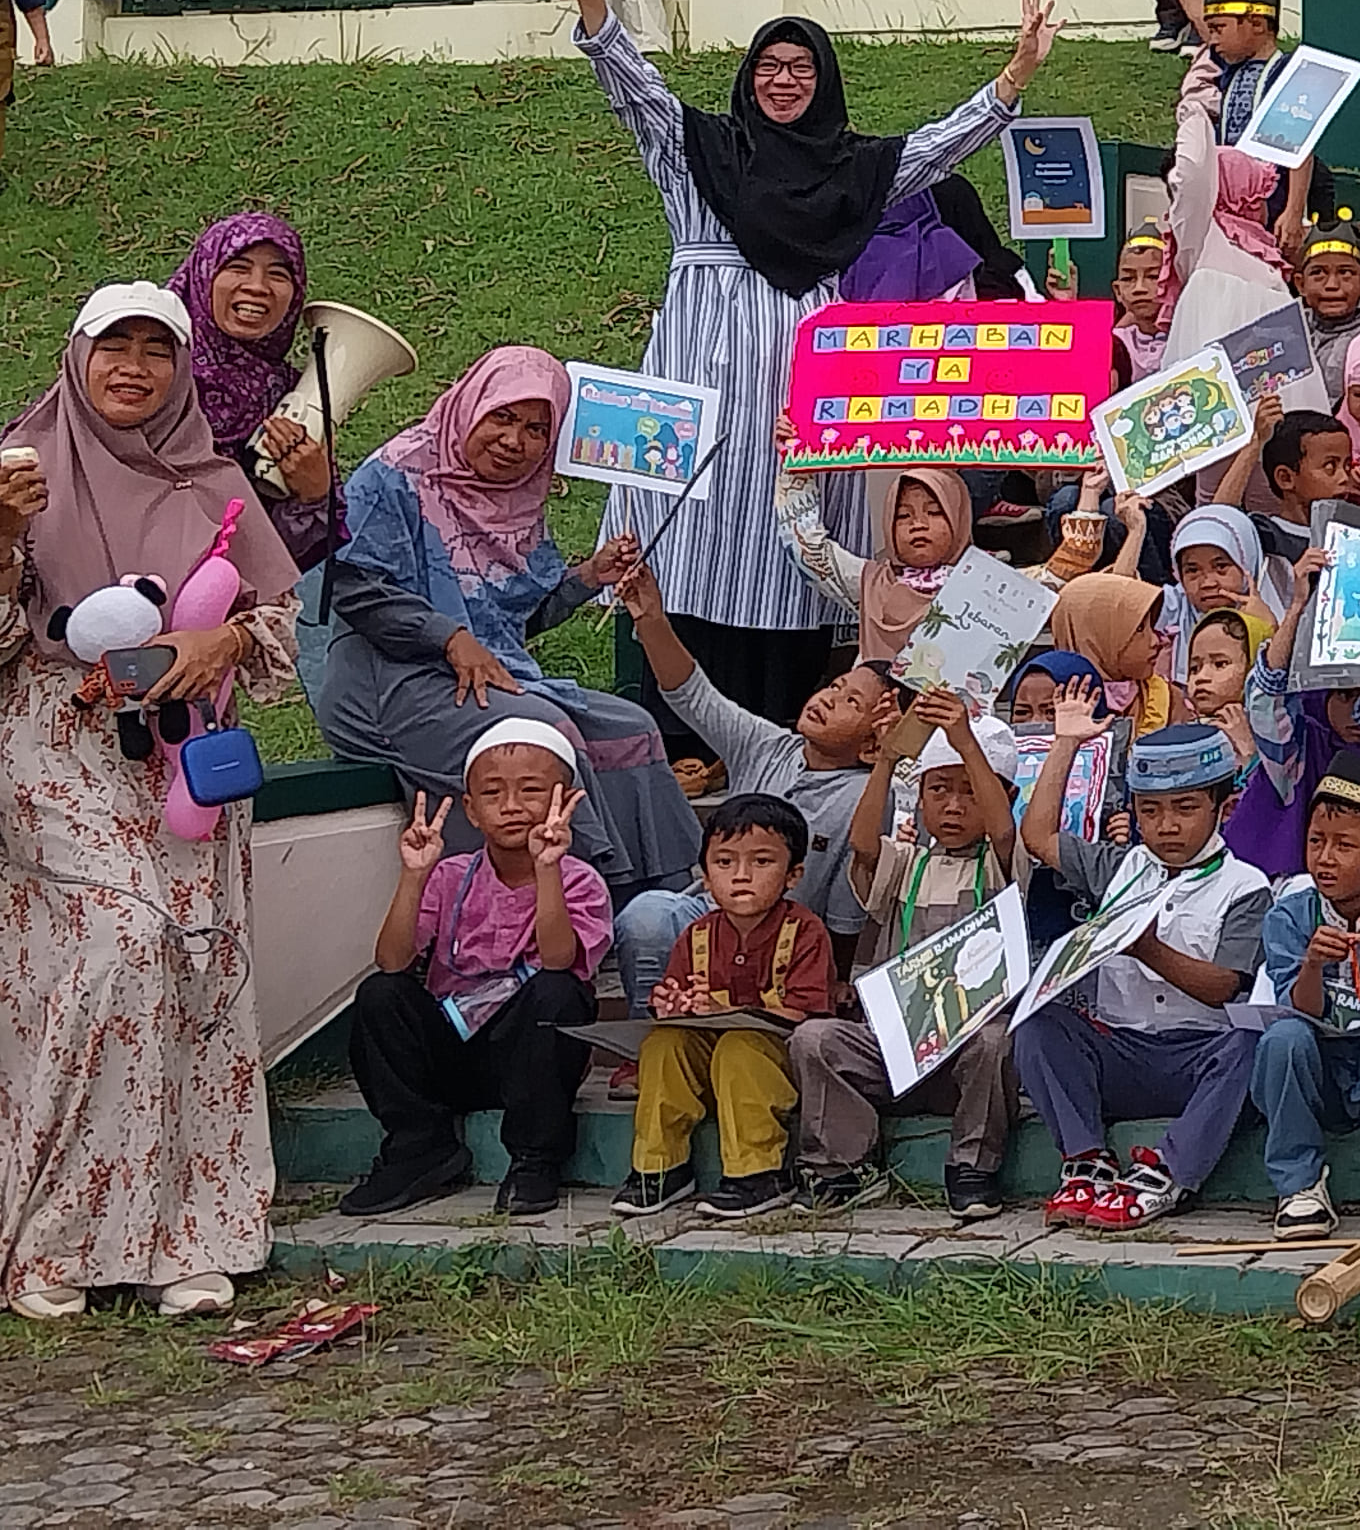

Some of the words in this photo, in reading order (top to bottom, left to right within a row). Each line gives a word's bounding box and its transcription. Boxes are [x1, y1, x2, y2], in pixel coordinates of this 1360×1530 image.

[816, 327, 1069, 351] MARHABAN
[904, 360, 964, 380] YA
[819, 397, 1081, 419] RAMADHAN
[932, 906, 996, 958] RAMADHAN
